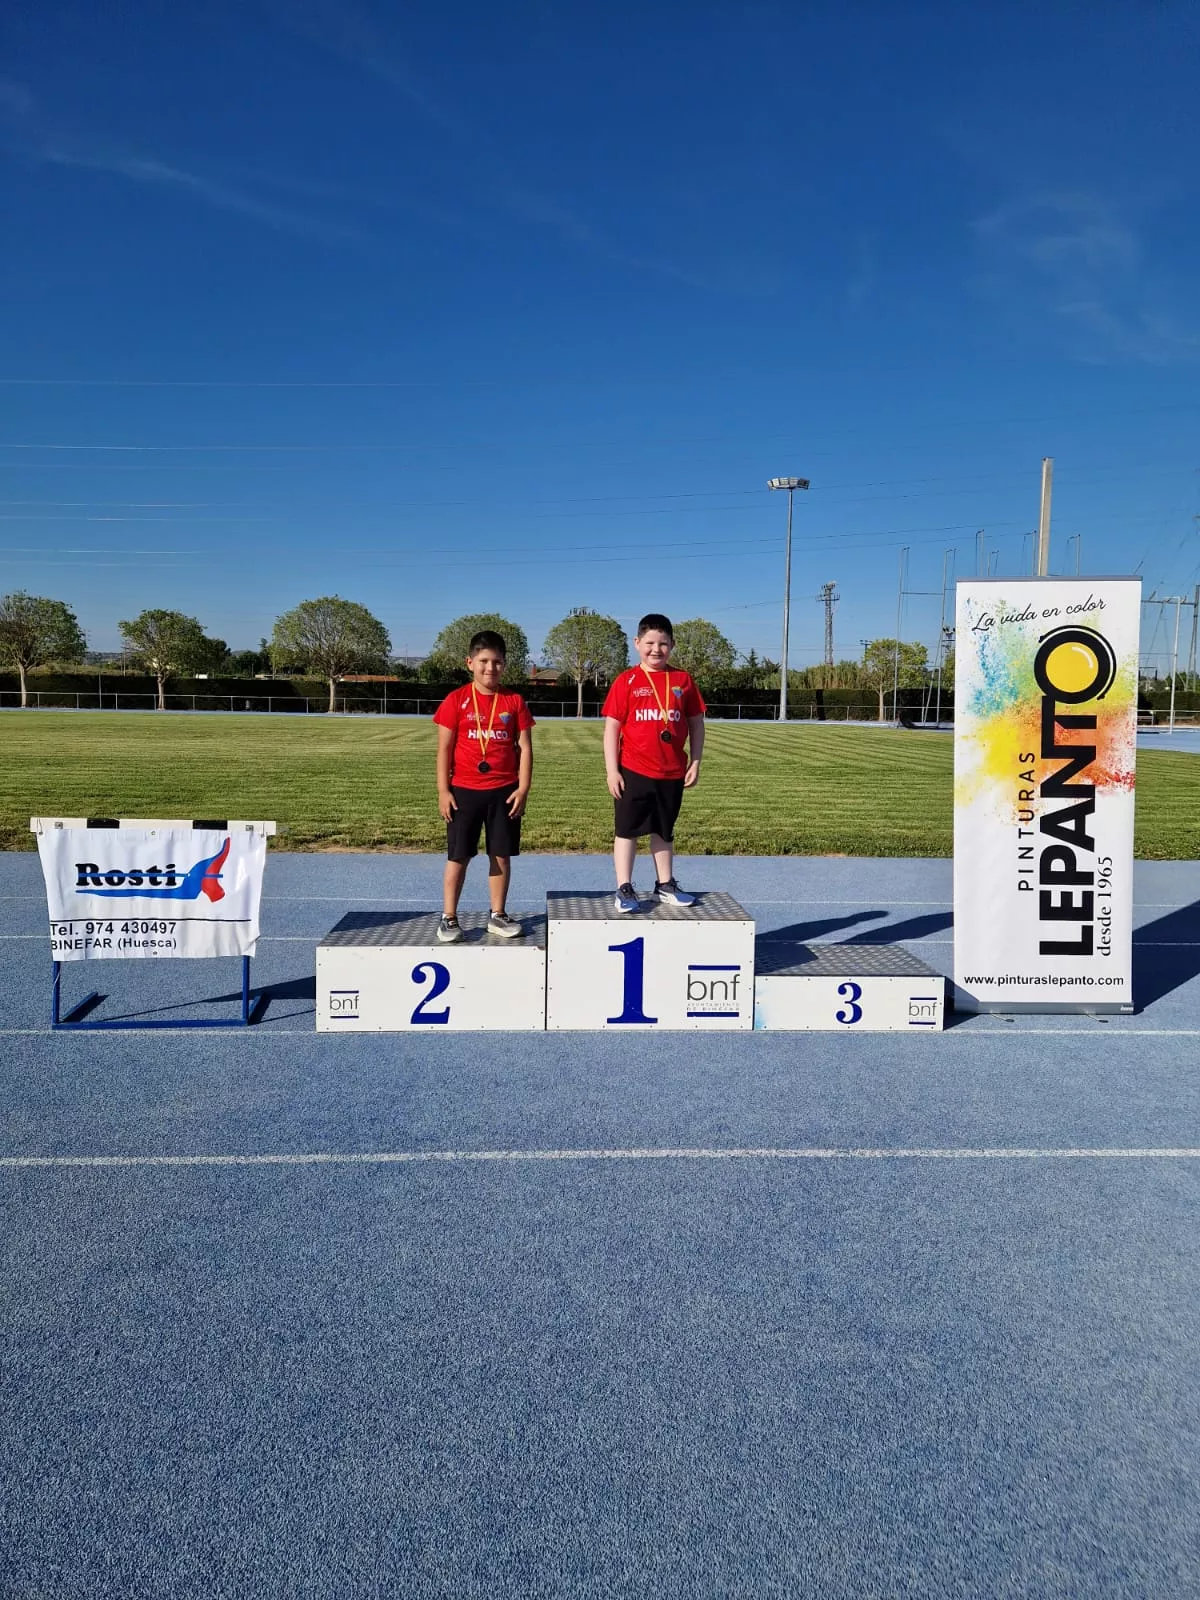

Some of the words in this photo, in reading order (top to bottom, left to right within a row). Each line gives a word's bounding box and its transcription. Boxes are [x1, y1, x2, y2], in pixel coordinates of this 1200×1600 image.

[972, 613, 996, 631] La
[1000, 603, 1038, 624] vida
[1042, 608, 1061, 618] en
[1066, 594, 1107, 614] color
[635, 708, 681, 722] HINACO
[1034, 625, 1116, 956] LEPANTO
[1018, 753, 1035, 891] PINTURAS
[75, 863, 177, 887] Rosti
[1098, 857, 1113, 897] 1965
[50, 923, 79, 936] Tel.
[86, 922, 114, 934] 974
[121, 922, 177, 935] 430497
[51, 938, 112, 950] BINEFAR
[118, 938, 177, 950] (Huesca)
[1097, 906, 1112, 956] desde
[410, 961, 451, 1025] 2
[607, 937, 658, 1024] 1
[687, 974, 740, 1001] bnf
[964, 973, 1124, 987] www.pinturaslepanto.com
[330, 995, 359, 1010] bnf
[835, 982, 863, 1024] 3
[909, 1002, 937, 1016] bnf
